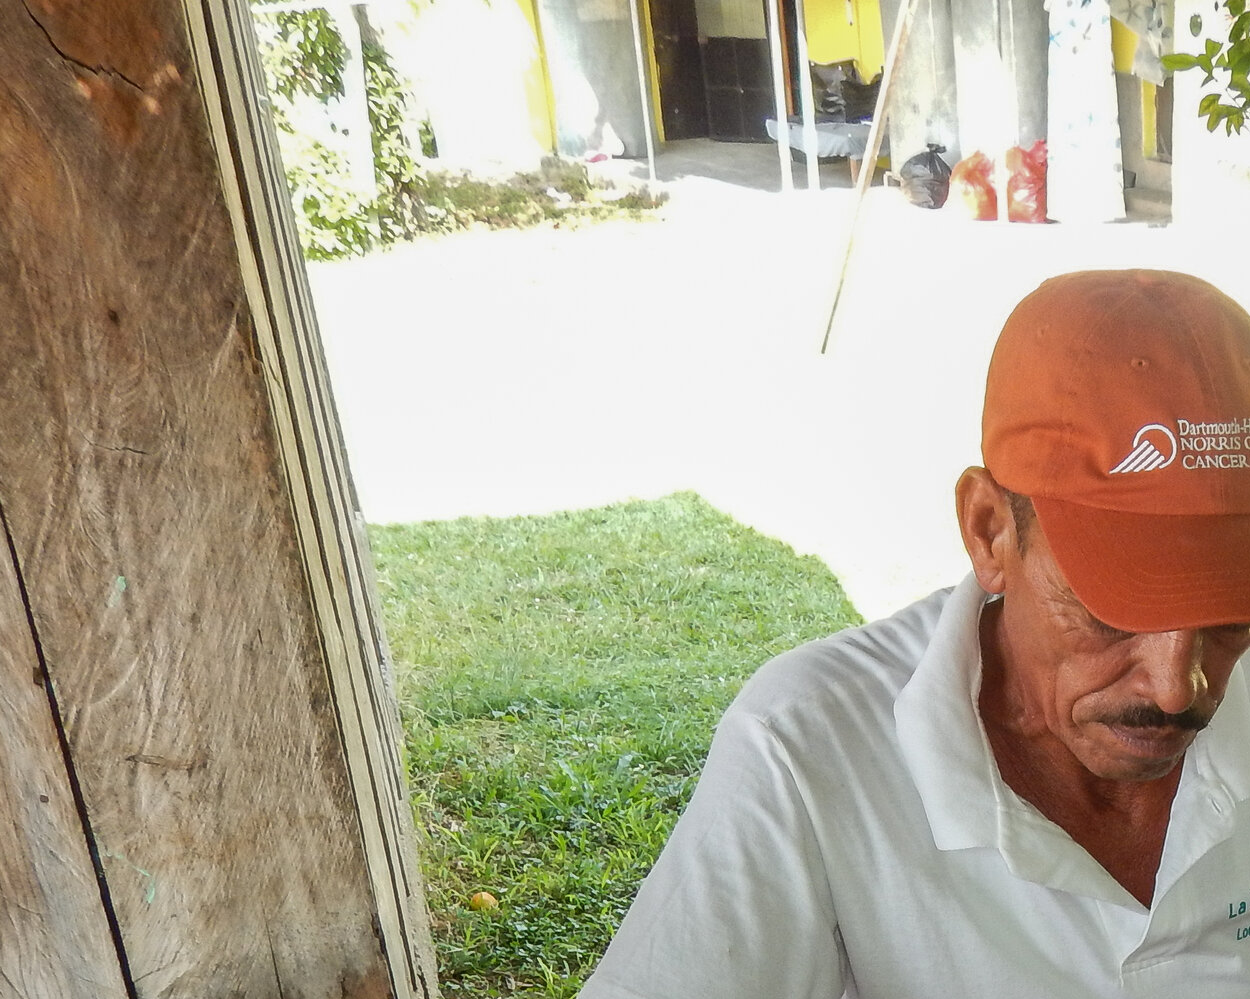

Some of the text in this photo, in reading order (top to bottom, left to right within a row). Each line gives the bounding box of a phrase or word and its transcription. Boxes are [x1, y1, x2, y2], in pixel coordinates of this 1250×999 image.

[1180, 436, 1241, 451] NORRIS
[1182, 454, 1250, 470] CANCER
[1229, 901, 1246, 919] La
